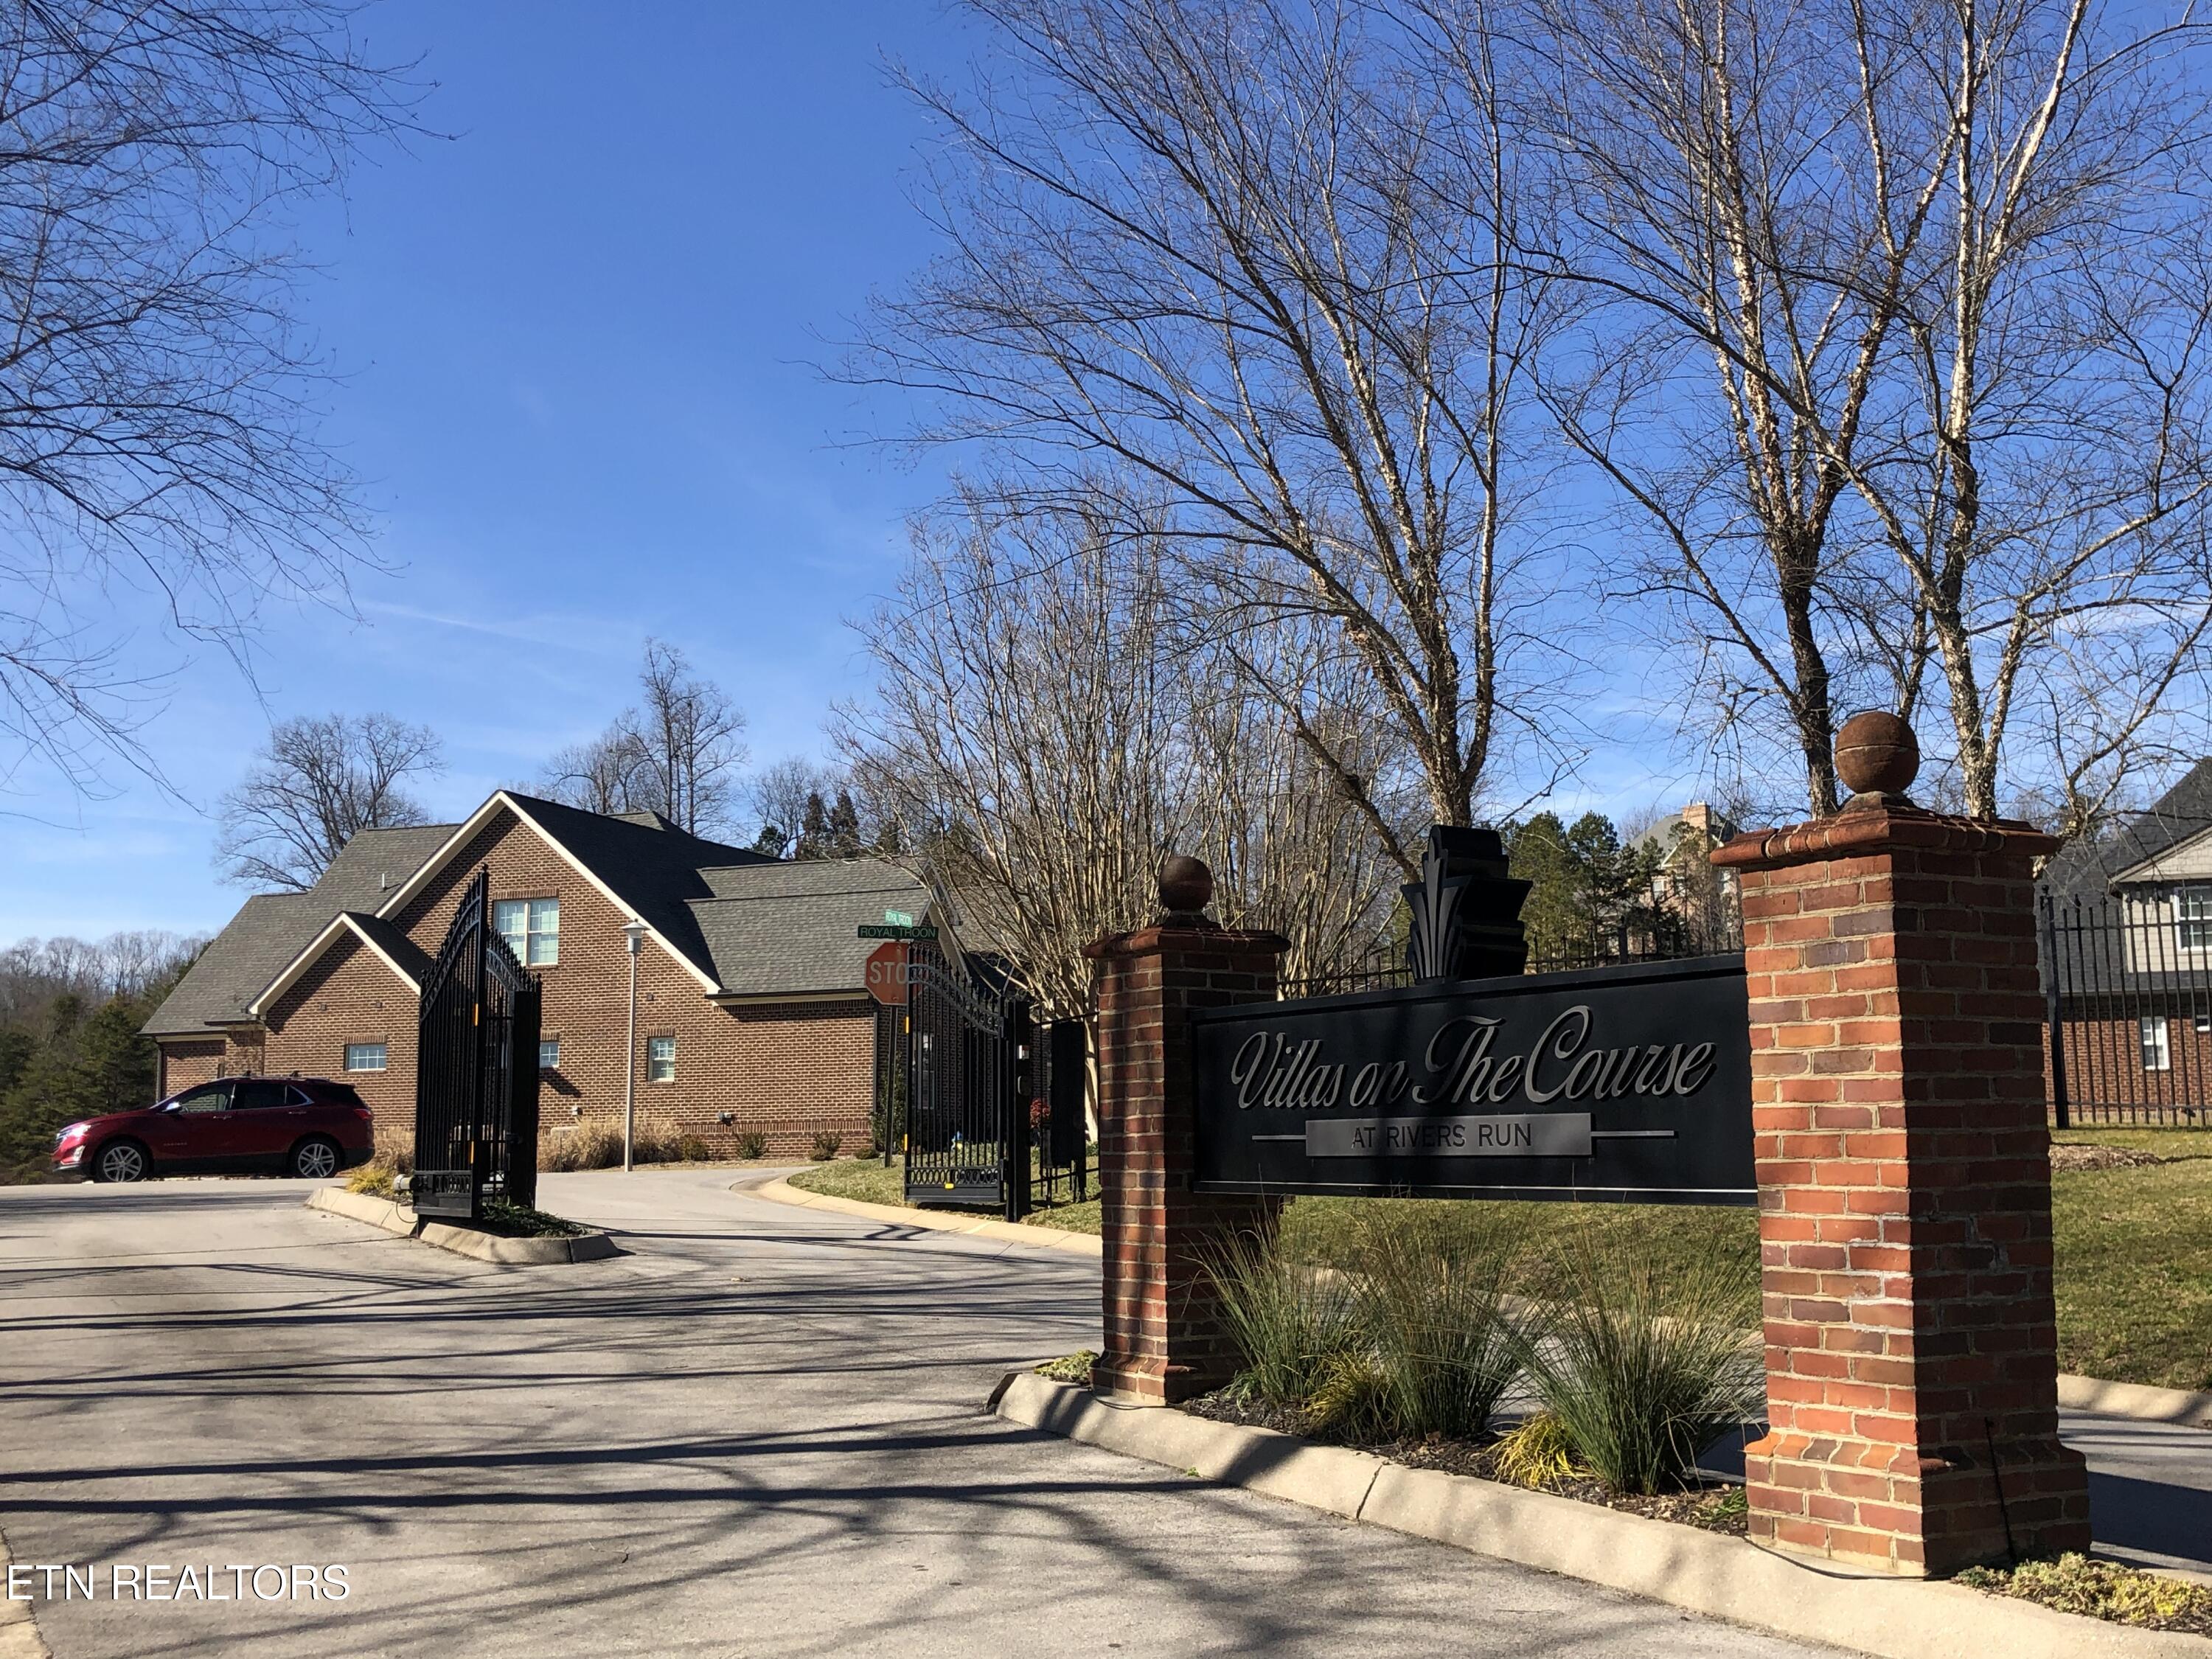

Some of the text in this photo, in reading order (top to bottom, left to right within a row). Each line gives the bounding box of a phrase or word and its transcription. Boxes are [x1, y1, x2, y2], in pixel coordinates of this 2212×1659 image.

[860, 927, 936, 938] ROYAL TROON
[869, 961, 914, 984] STO
[1231, 1004, 1718, 1109] Villas on The Course
[1352, 1122, 1532, 1148] AT RIVERS RUN
